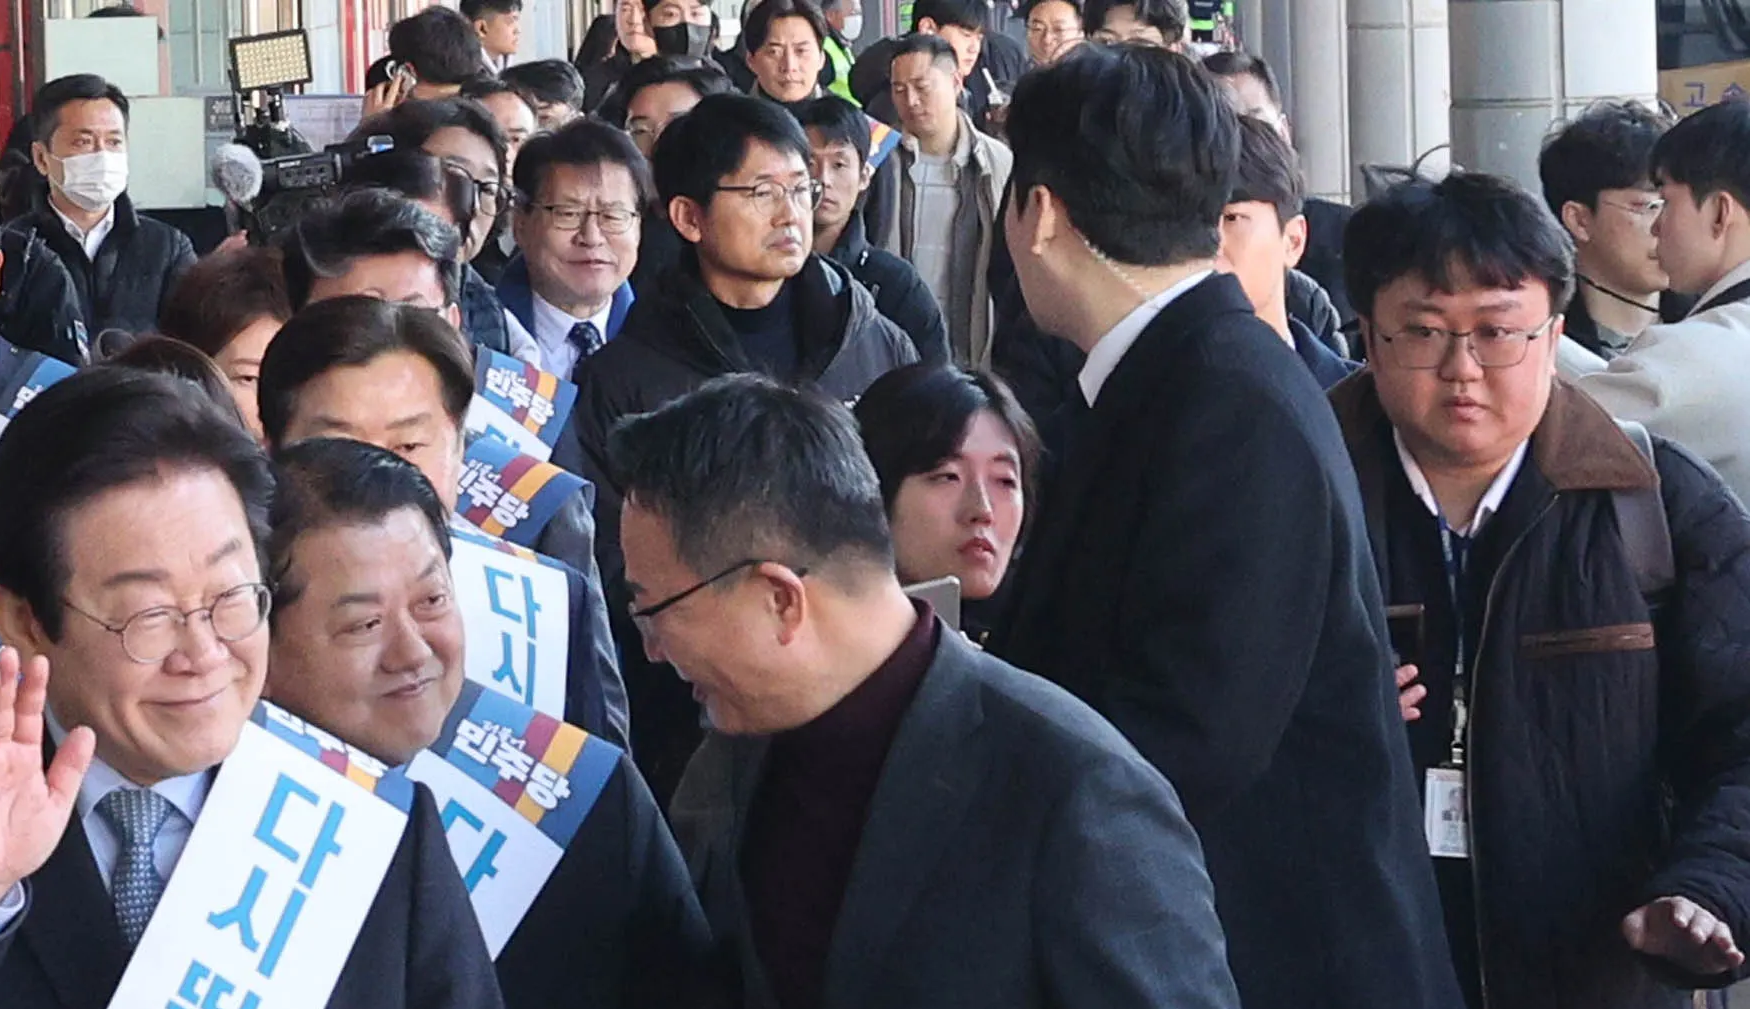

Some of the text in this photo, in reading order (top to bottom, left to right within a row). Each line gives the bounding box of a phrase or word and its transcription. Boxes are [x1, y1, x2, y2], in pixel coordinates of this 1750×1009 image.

[485, 367, 555, 425] 민주당
[483, 564, 542, 708] 다시
[452, 719, 571, 809] 민주당
[207, 770, 345, 979] 다시
